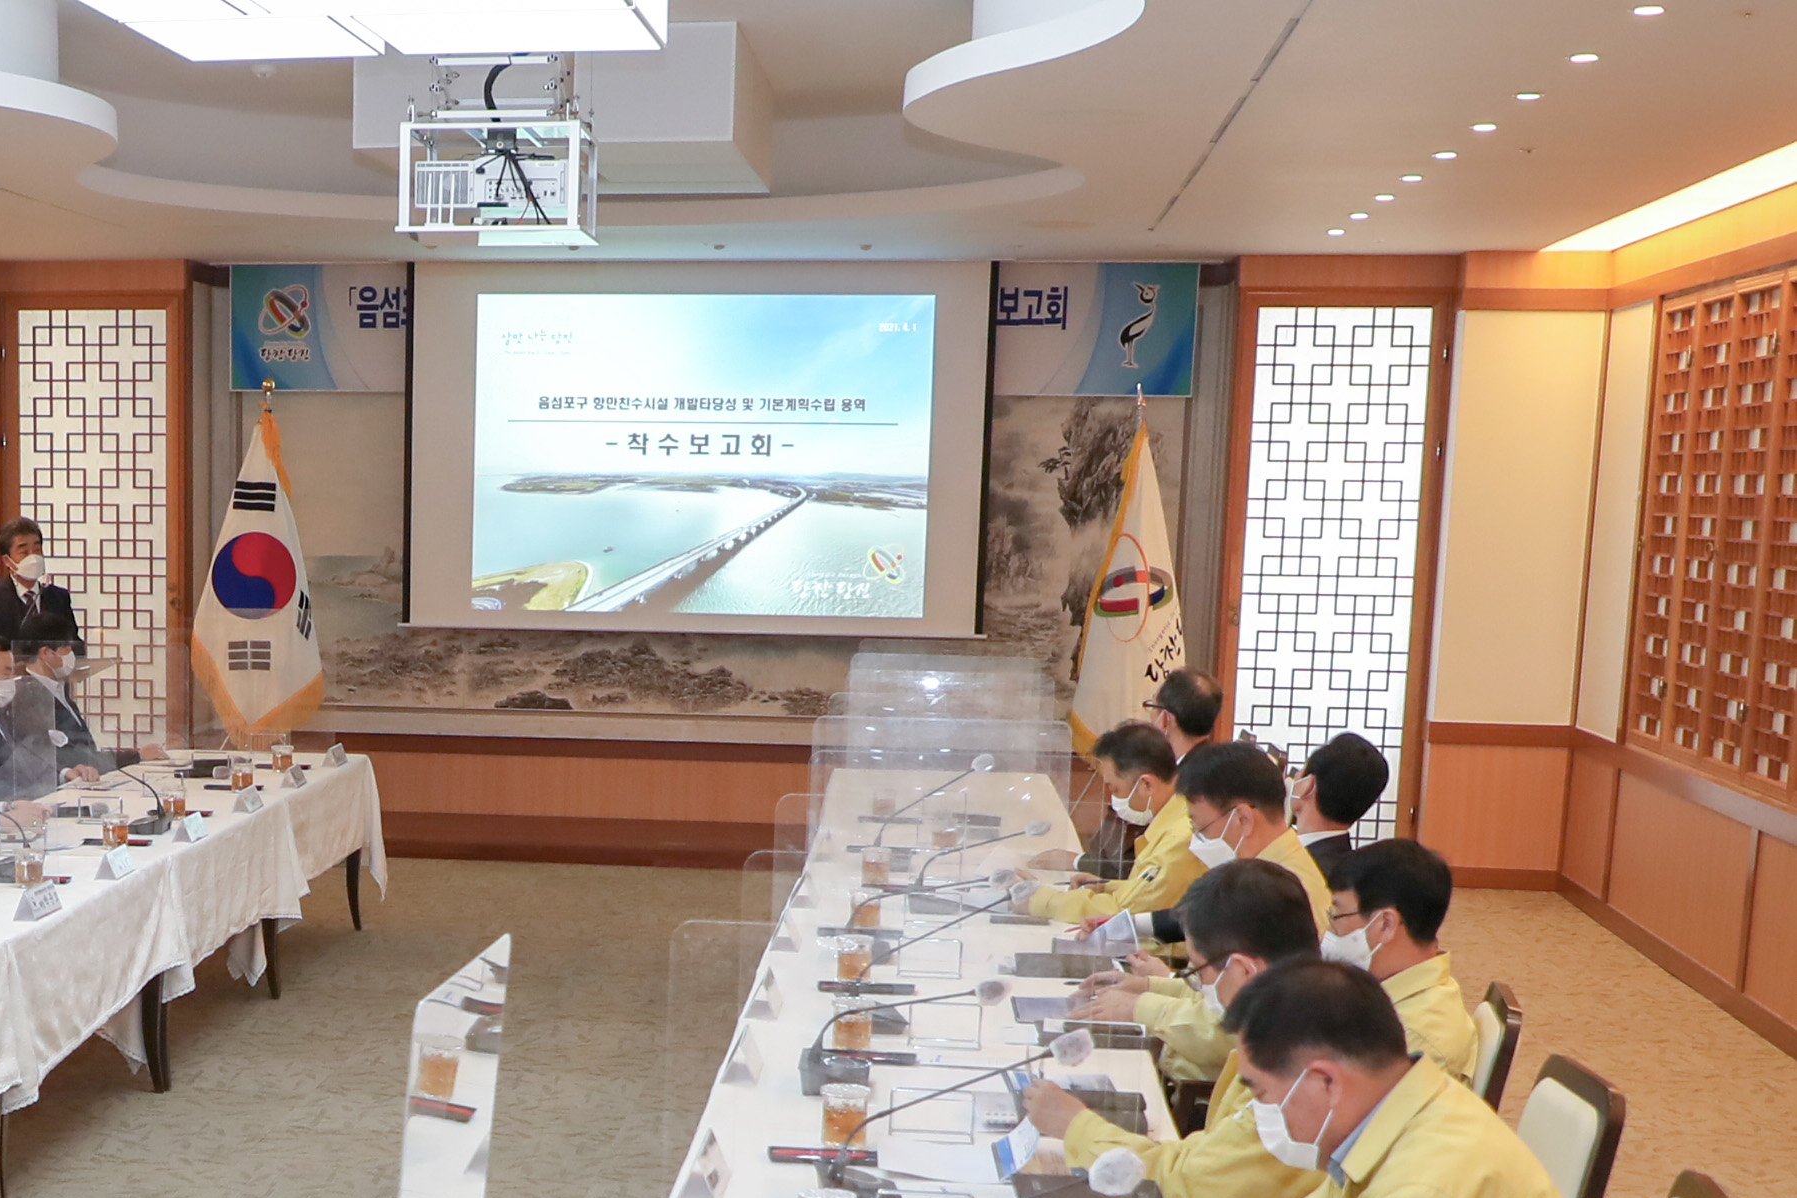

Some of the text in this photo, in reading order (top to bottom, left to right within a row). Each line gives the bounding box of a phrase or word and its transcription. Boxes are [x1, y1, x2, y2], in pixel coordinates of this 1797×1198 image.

[996, 286, 1068, 330] 보고회
[539, 396, 866, 412] 음섬포구 항만친수시설 개발타당성 및 기본계획수립 용역
